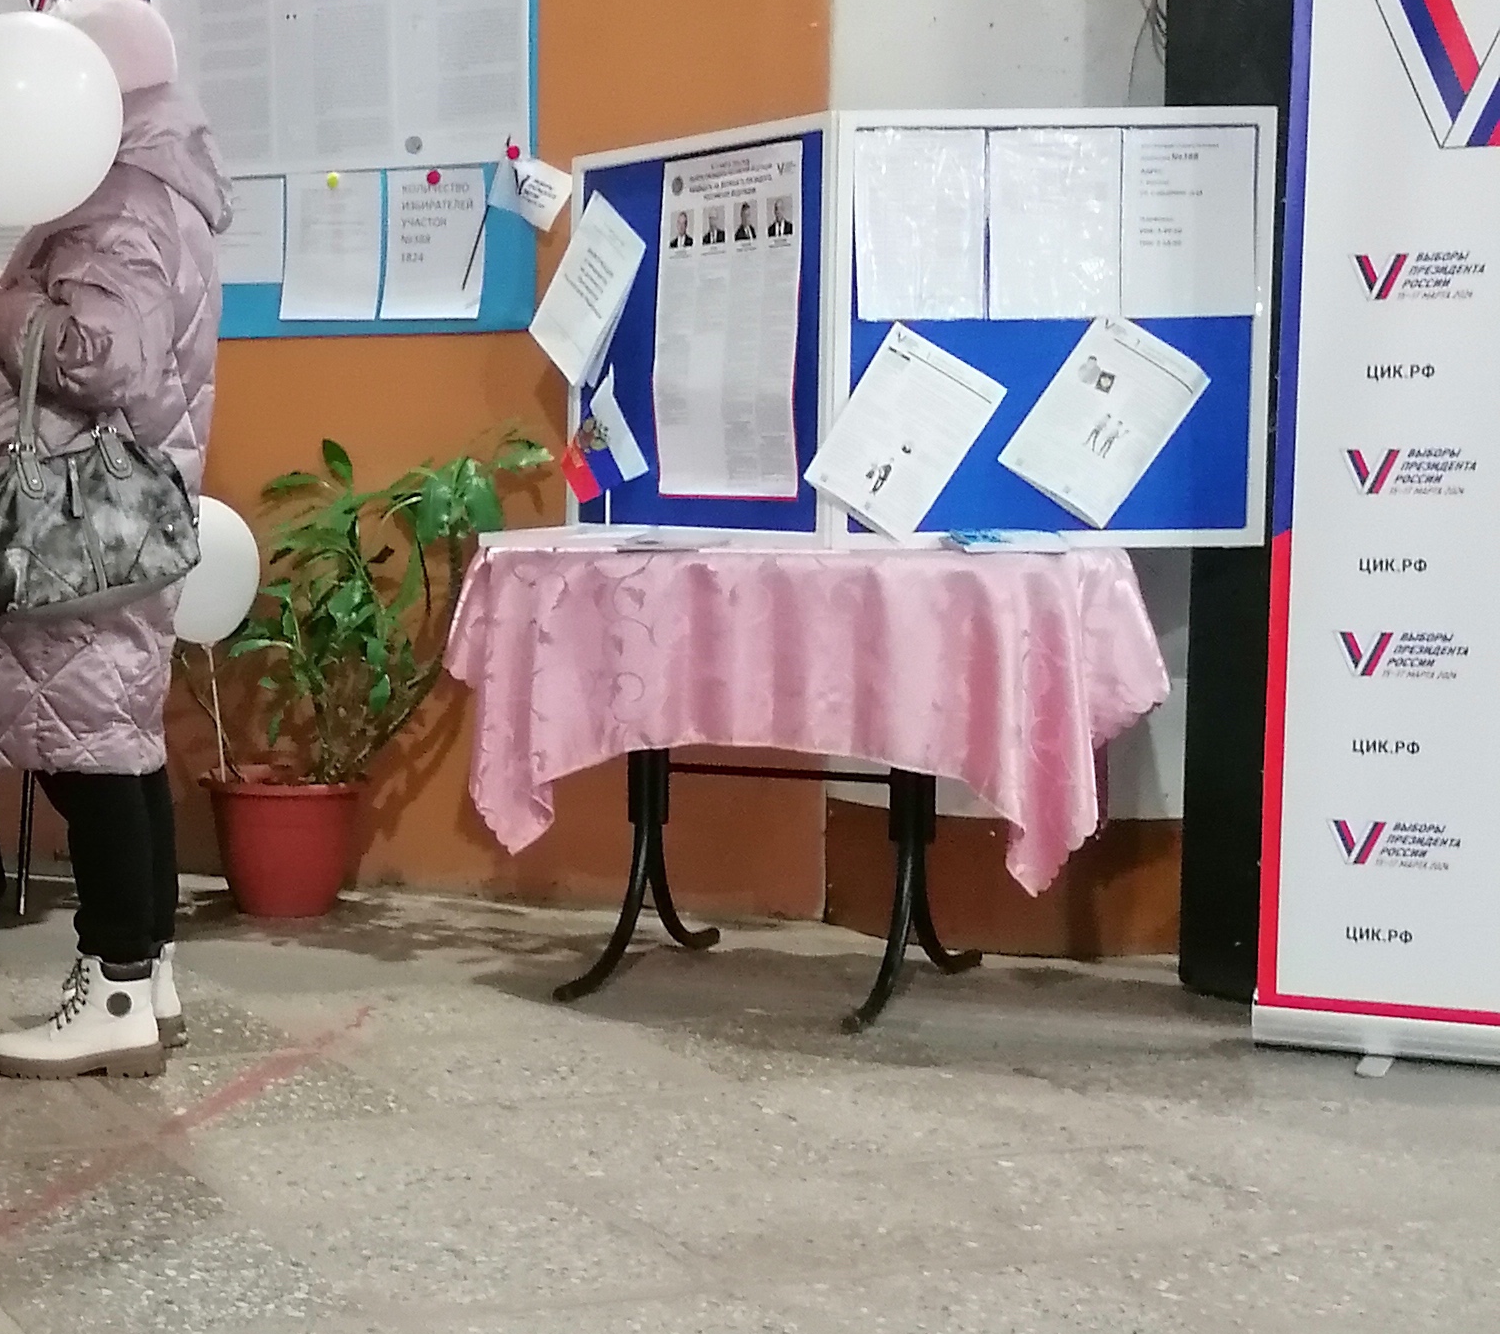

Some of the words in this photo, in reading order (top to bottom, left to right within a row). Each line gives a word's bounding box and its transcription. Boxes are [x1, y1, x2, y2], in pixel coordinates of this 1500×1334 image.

[401, 198, 474, 211] ИЗБИРАТЕЛЕЙ
[1415, 250, 1470, 263] ВЫБОРЫ
[1408, 263, 1486, 276] ПРЕЗИДЕНТА
[1402, 277, 1451, 289] РОССИИ
[1367, 362, 1435, 383] ЦИК.РФ
[1407, 447, 1462, 459] ВЫБОРЫ
[1400, 460, 1477, 472] ПРЕЗИДЕНТА
[1394, 474, 1443, 485] РОССИИ
[1359, 557, 1428, 575] ЦИК.РФ
[1399, 632, 1454, 642] ВЫБОРЫ
[1393, 644, 1469, 657] ПРЕЗИДЕНТА
[1387, 657, 1436, 668] РОССИИ
[1352, 738, 1420, 756] ЦИК.РФ
[1392, 821, 1446, 834] ВЫБОРЫ
[1386, 833, 1461, 849] ПРЕЗИДЕНТА
[1380, 847, 1428, 858] РОССИИ
[1346, 926, 1413, 945] ЦИК.РФ
